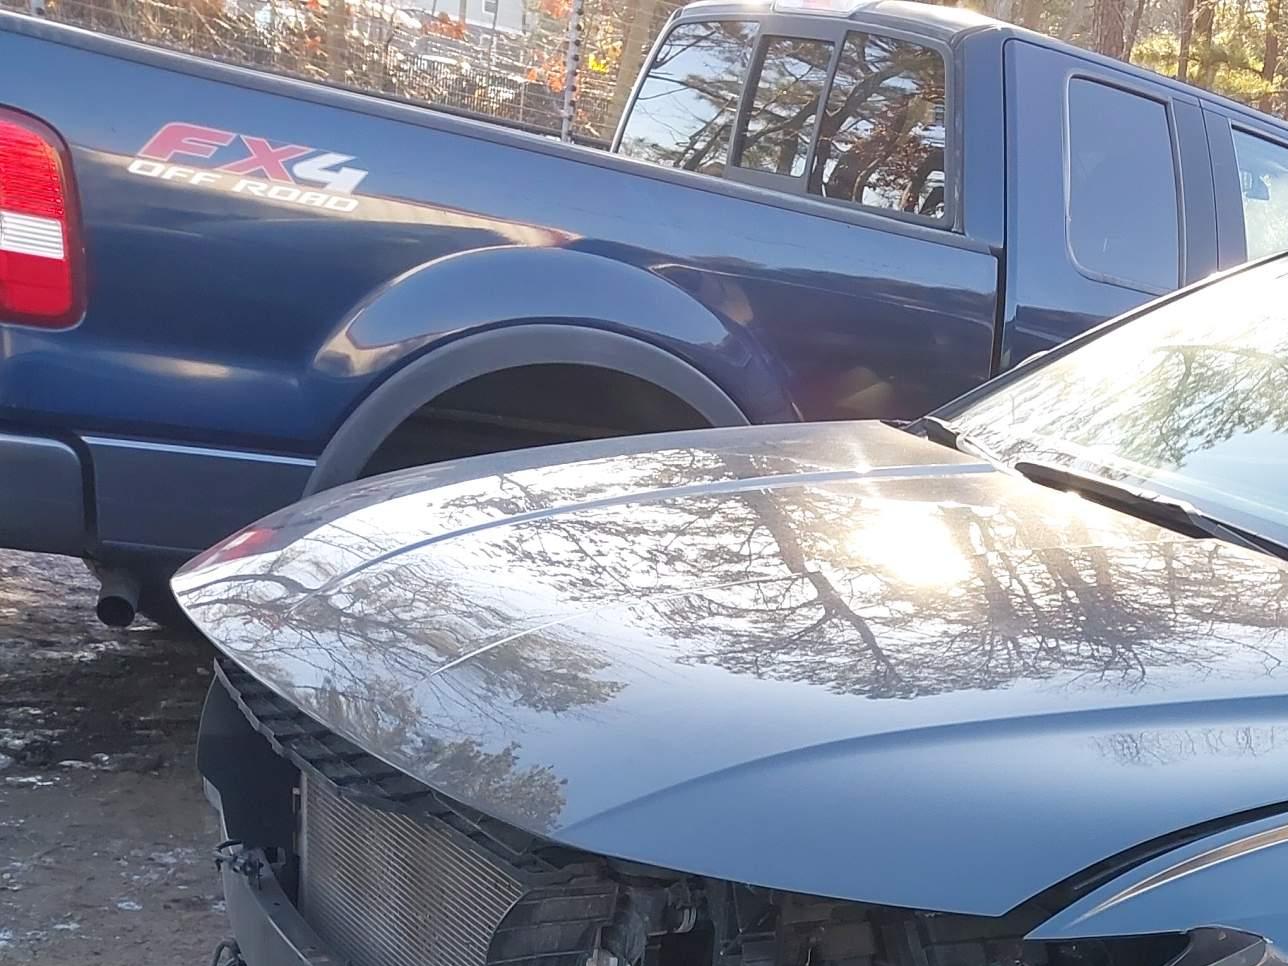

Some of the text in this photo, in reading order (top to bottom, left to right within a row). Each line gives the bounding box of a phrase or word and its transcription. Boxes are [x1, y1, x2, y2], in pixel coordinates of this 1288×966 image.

[127, 159, 360, 213] OFF ROAD
[137, 121, 369, 195] FX4
